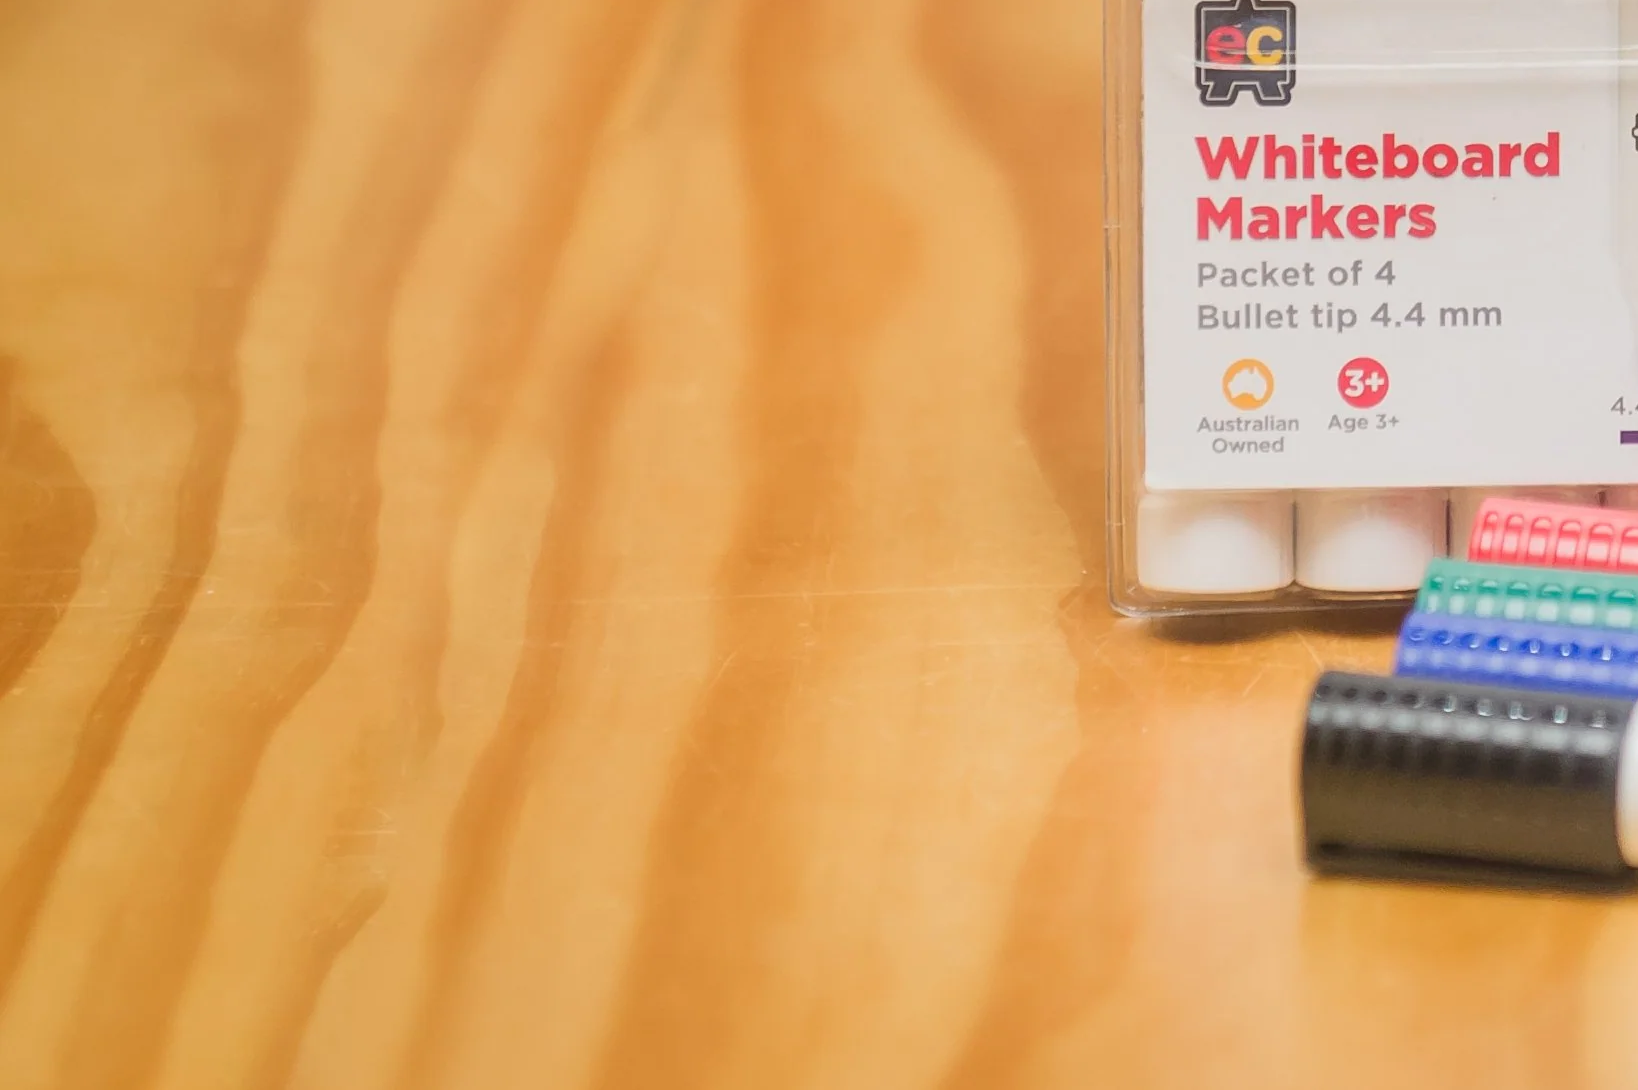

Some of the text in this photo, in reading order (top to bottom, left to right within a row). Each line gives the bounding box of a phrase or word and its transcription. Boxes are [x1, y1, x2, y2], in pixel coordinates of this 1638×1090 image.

[1206, 25, 1283, 71] ec
[1195, 131, 1561, 181] Whiteboard
[1196, 194, 1438, 241] Markers
[1197, 259, 1397, 289] Packet of 4
[1197, 301, 1503, 334] Bullet tip 4.4 mm
[1344, 368, 1386, 398] 3+
[1196, 414, 1300, 433] Australian
[1327, 413, 1400, 434] Age 3+
[1211, 435, 1285, 454] Owned
